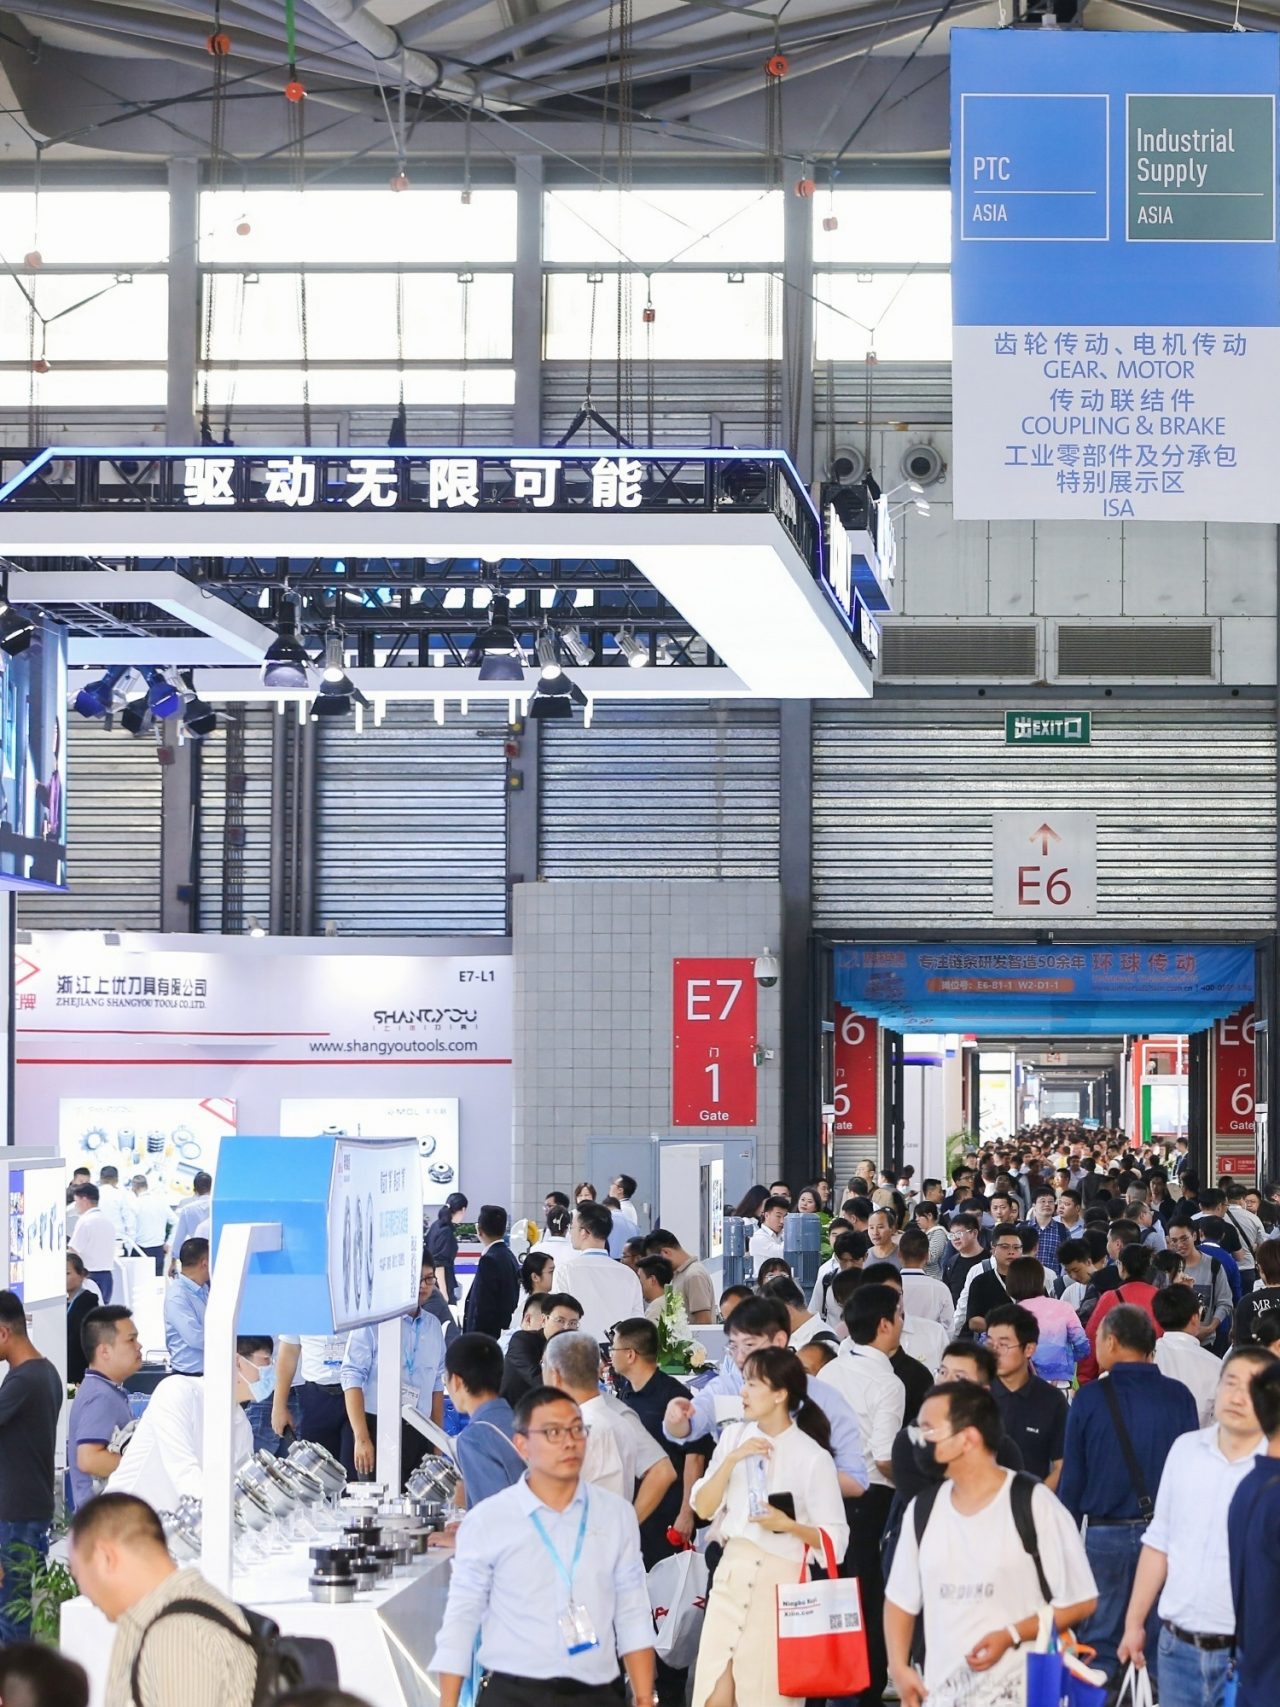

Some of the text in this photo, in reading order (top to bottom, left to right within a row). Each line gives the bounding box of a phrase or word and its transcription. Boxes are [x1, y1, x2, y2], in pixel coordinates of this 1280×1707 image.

[1137, 127, 1235, 154] Industrial
[973, 157, 1011, 182] PTC
[1137, 158, 1208, 188] Supply
[972, 205, 1008, 223] ASIA
[1137, 206, 1174, 225] ASIA
[994, 332, 1248, 357] 齿轮传动、电机传动
[1116, 361, 1195, 380] MOTOR
[1049, 388, 1196, 413] 传动联结件
[1021, 416, 1226, 437] COUPLING & BRAKE
[1004, 444, 1238, 469] 工业零部件及分承包
[184, 457, 644, 508] 驱动无限可能
[1056, 471, 1186, 495] 特别展示区
[1102, 499, 1134, 518] ISA
[1018, 866, 1071, 906] E6
[1091, 952, 1198, 973] 环球传动
[56, 975, 208, 998] 浙江上优刀具有限公司
[459, 970, 495, 982] E7-L1
[56, 997, 105, 1008] ZHEJIANG
[107, 998, 154, 1009] SHANGYOU
[687, 979, 744, 1021] E7
[309, 1039, 478, 1056] www.shangyoutools.com
[708, 1046, 720, 1058] 门
[704, 1063, 720, 1103] 1
[1237, 1067, 1247, 1078] 门
[1231, 1082, 1254, 1116] 6
[699, 1109, 730, 1122] Gate
[836, 1121, 853, 1131] ate
[1229, 1120, 1255, 1131] Gate
